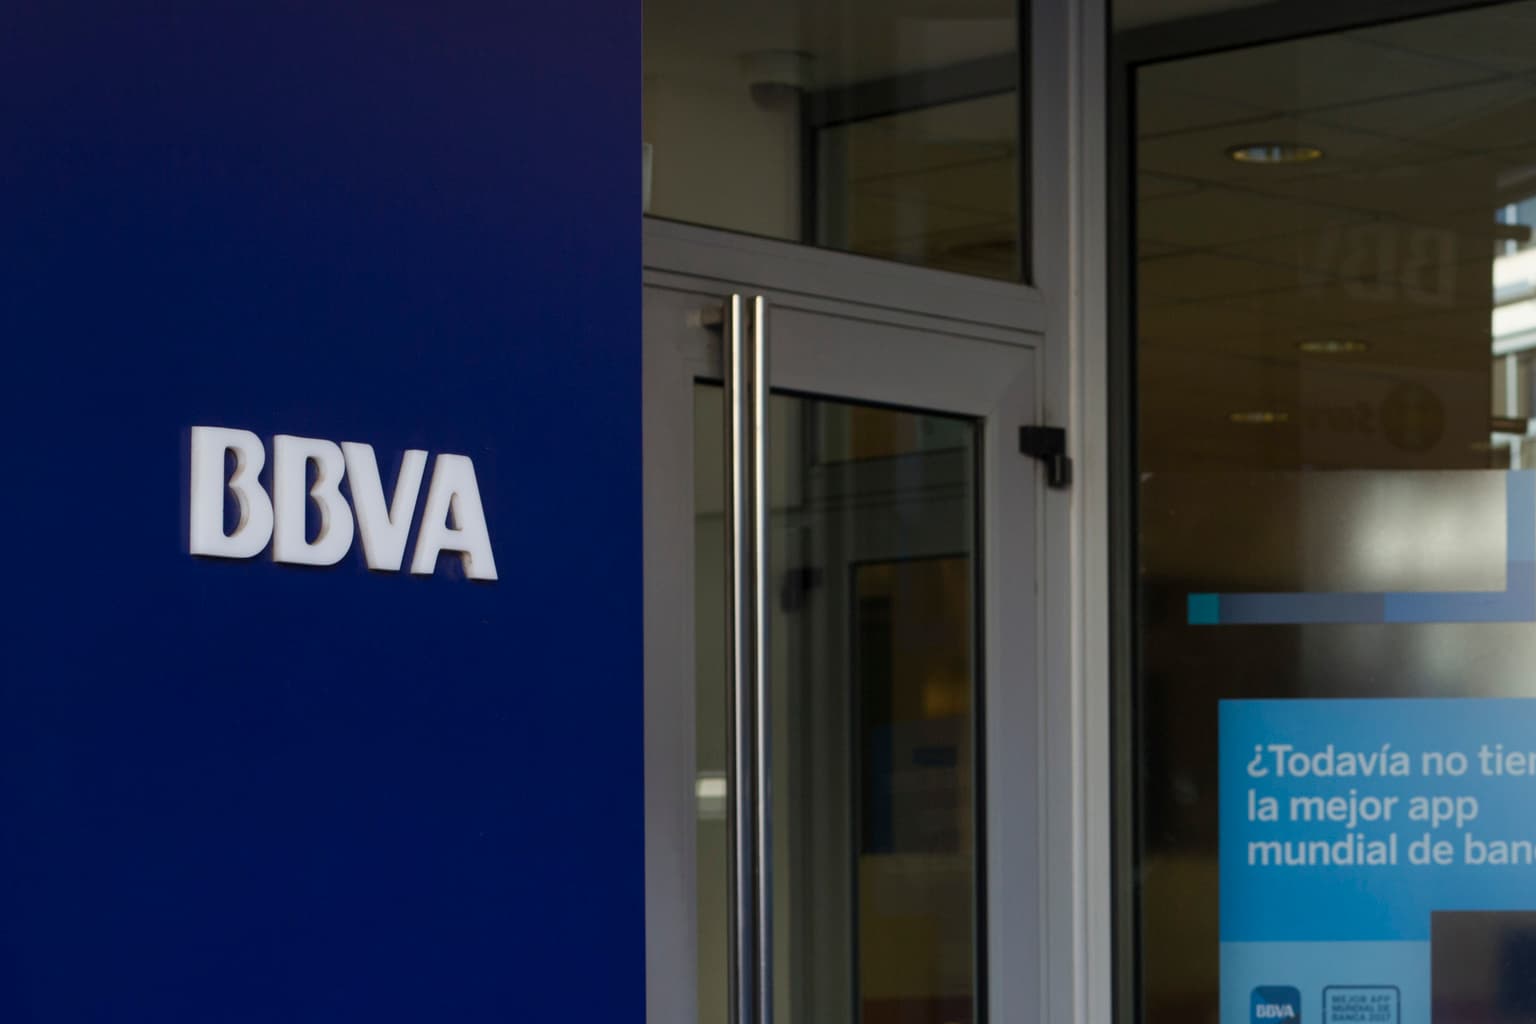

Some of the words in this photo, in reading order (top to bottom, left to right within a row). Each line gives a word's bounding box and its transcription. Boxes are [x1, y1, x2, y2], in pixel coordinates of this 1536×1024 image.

[190, 426, 498, 580] BBVA
[1247, 743, 1410, 777] ¿Todavía
[1422, 751, 1469, 777] no
[1248, 789, 1281, 822] la
[1289, 790, 1398, 828] mejor
[1408, 797, 1478, 828] app
[1248, 834, 1398, 866] mundial
[1408, 833, 1455, 866] de
[1256, 1004, 1295, 1019] BBVA
